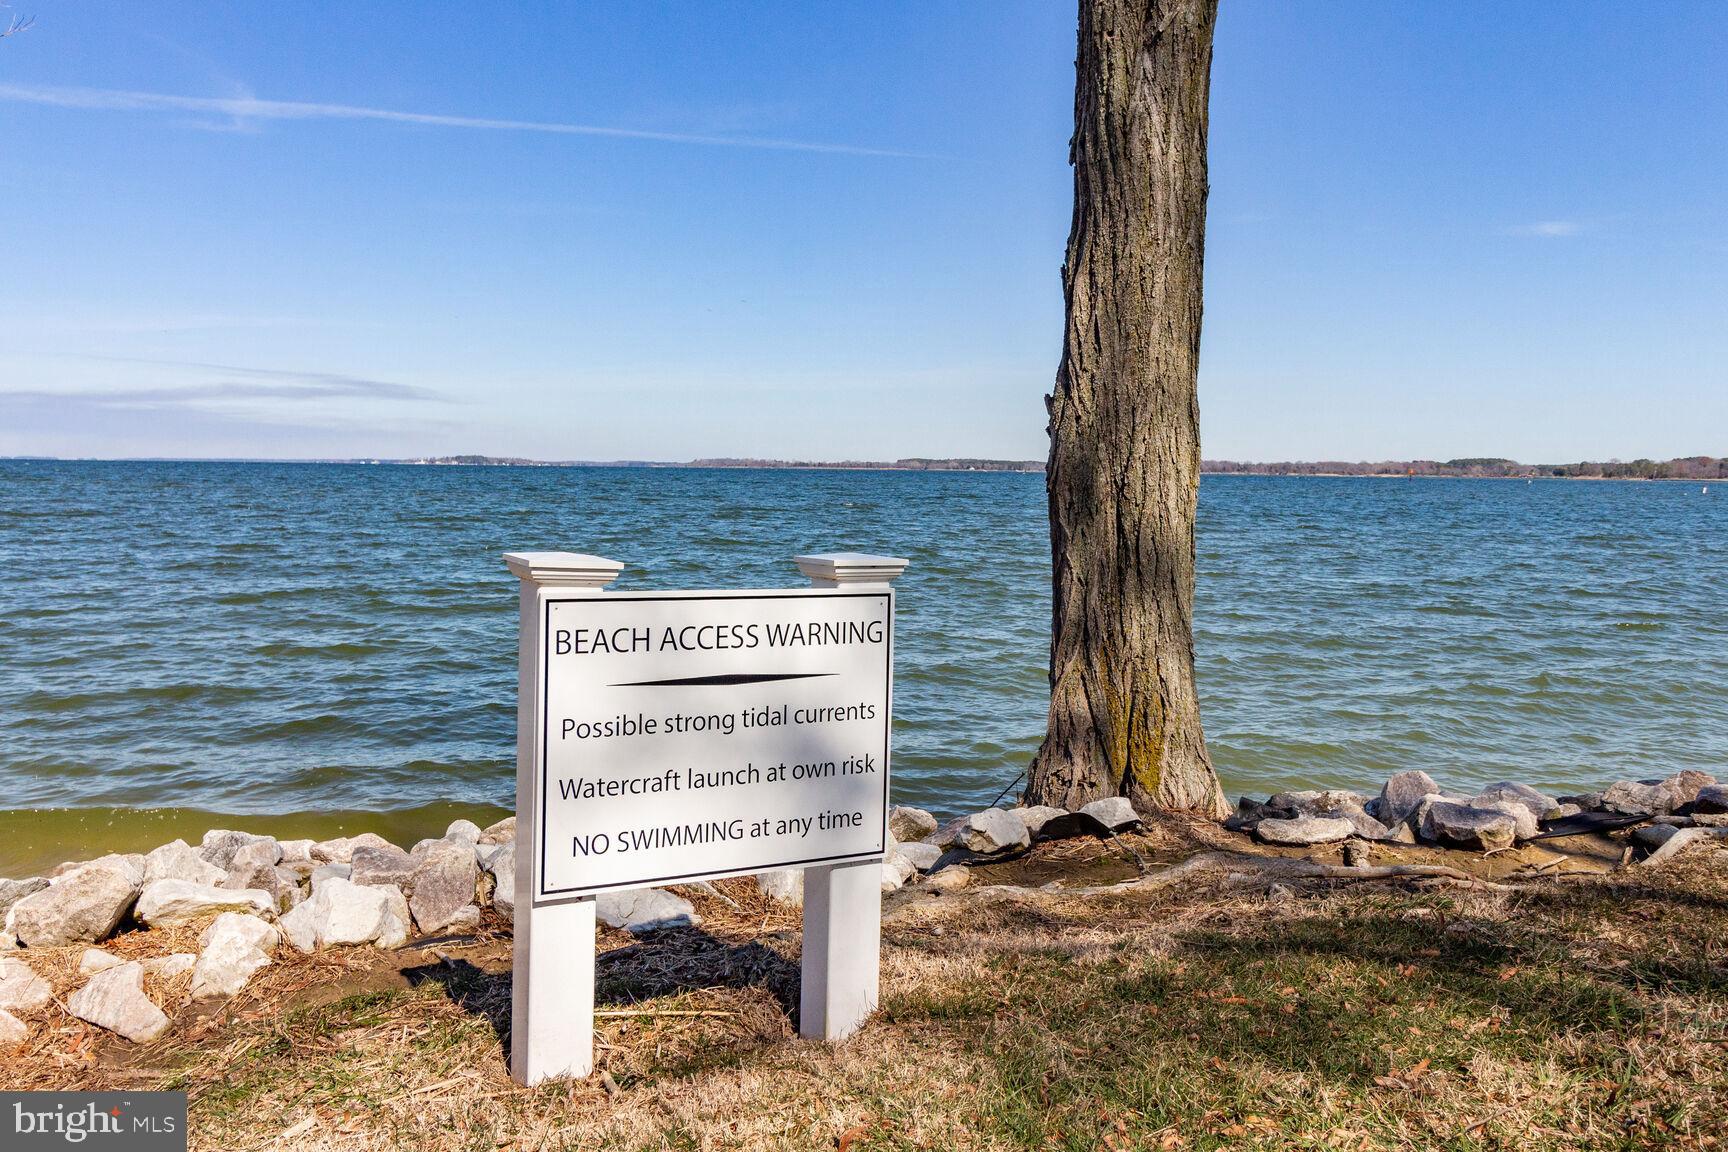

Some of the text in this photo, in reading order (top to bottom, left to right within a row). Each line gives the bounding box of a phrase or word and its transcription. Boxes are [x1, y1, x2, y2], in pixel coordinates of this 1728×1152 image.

[555, 620, 883, 656] BEACH ACCESS WARNING
[561, 701, 876, 741] Possible strong tidal currents
[558, 752, 876, 801] Watercraft launch at own risk
[572, 809, 863, 858] NO SWIMMING at any time
